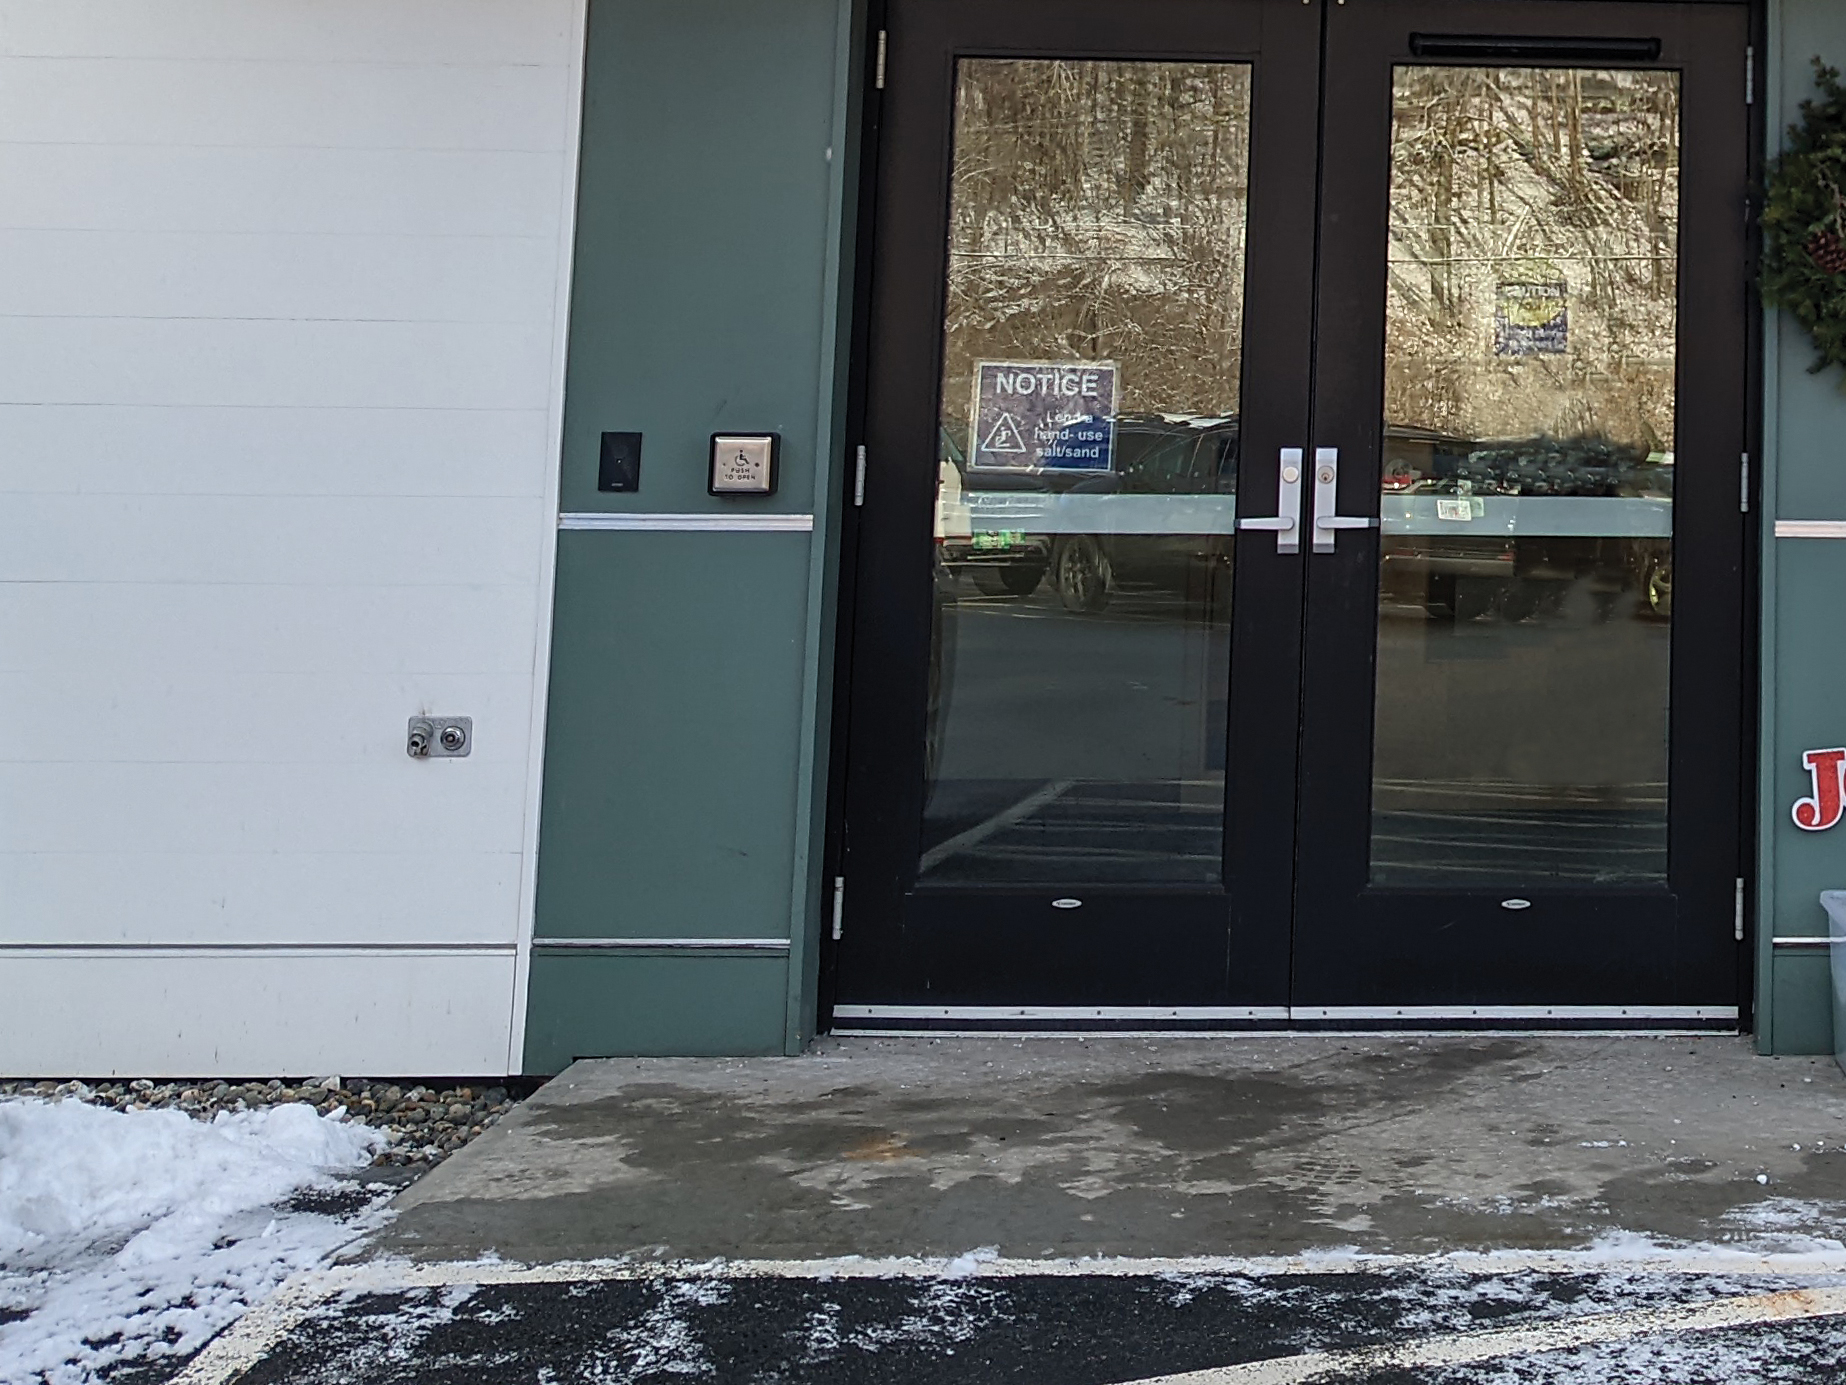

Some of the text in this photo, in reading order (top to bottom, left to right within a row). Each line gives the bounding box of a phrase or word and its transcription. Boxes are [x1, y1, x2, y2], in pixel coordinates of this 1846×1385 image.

[996, 372, 1099, 397] NOTICE
[1085, 414, 1094, 424] a
[1078, 430, 1104, 441] use
[1035, 444, 1100, 458] salt/sand
